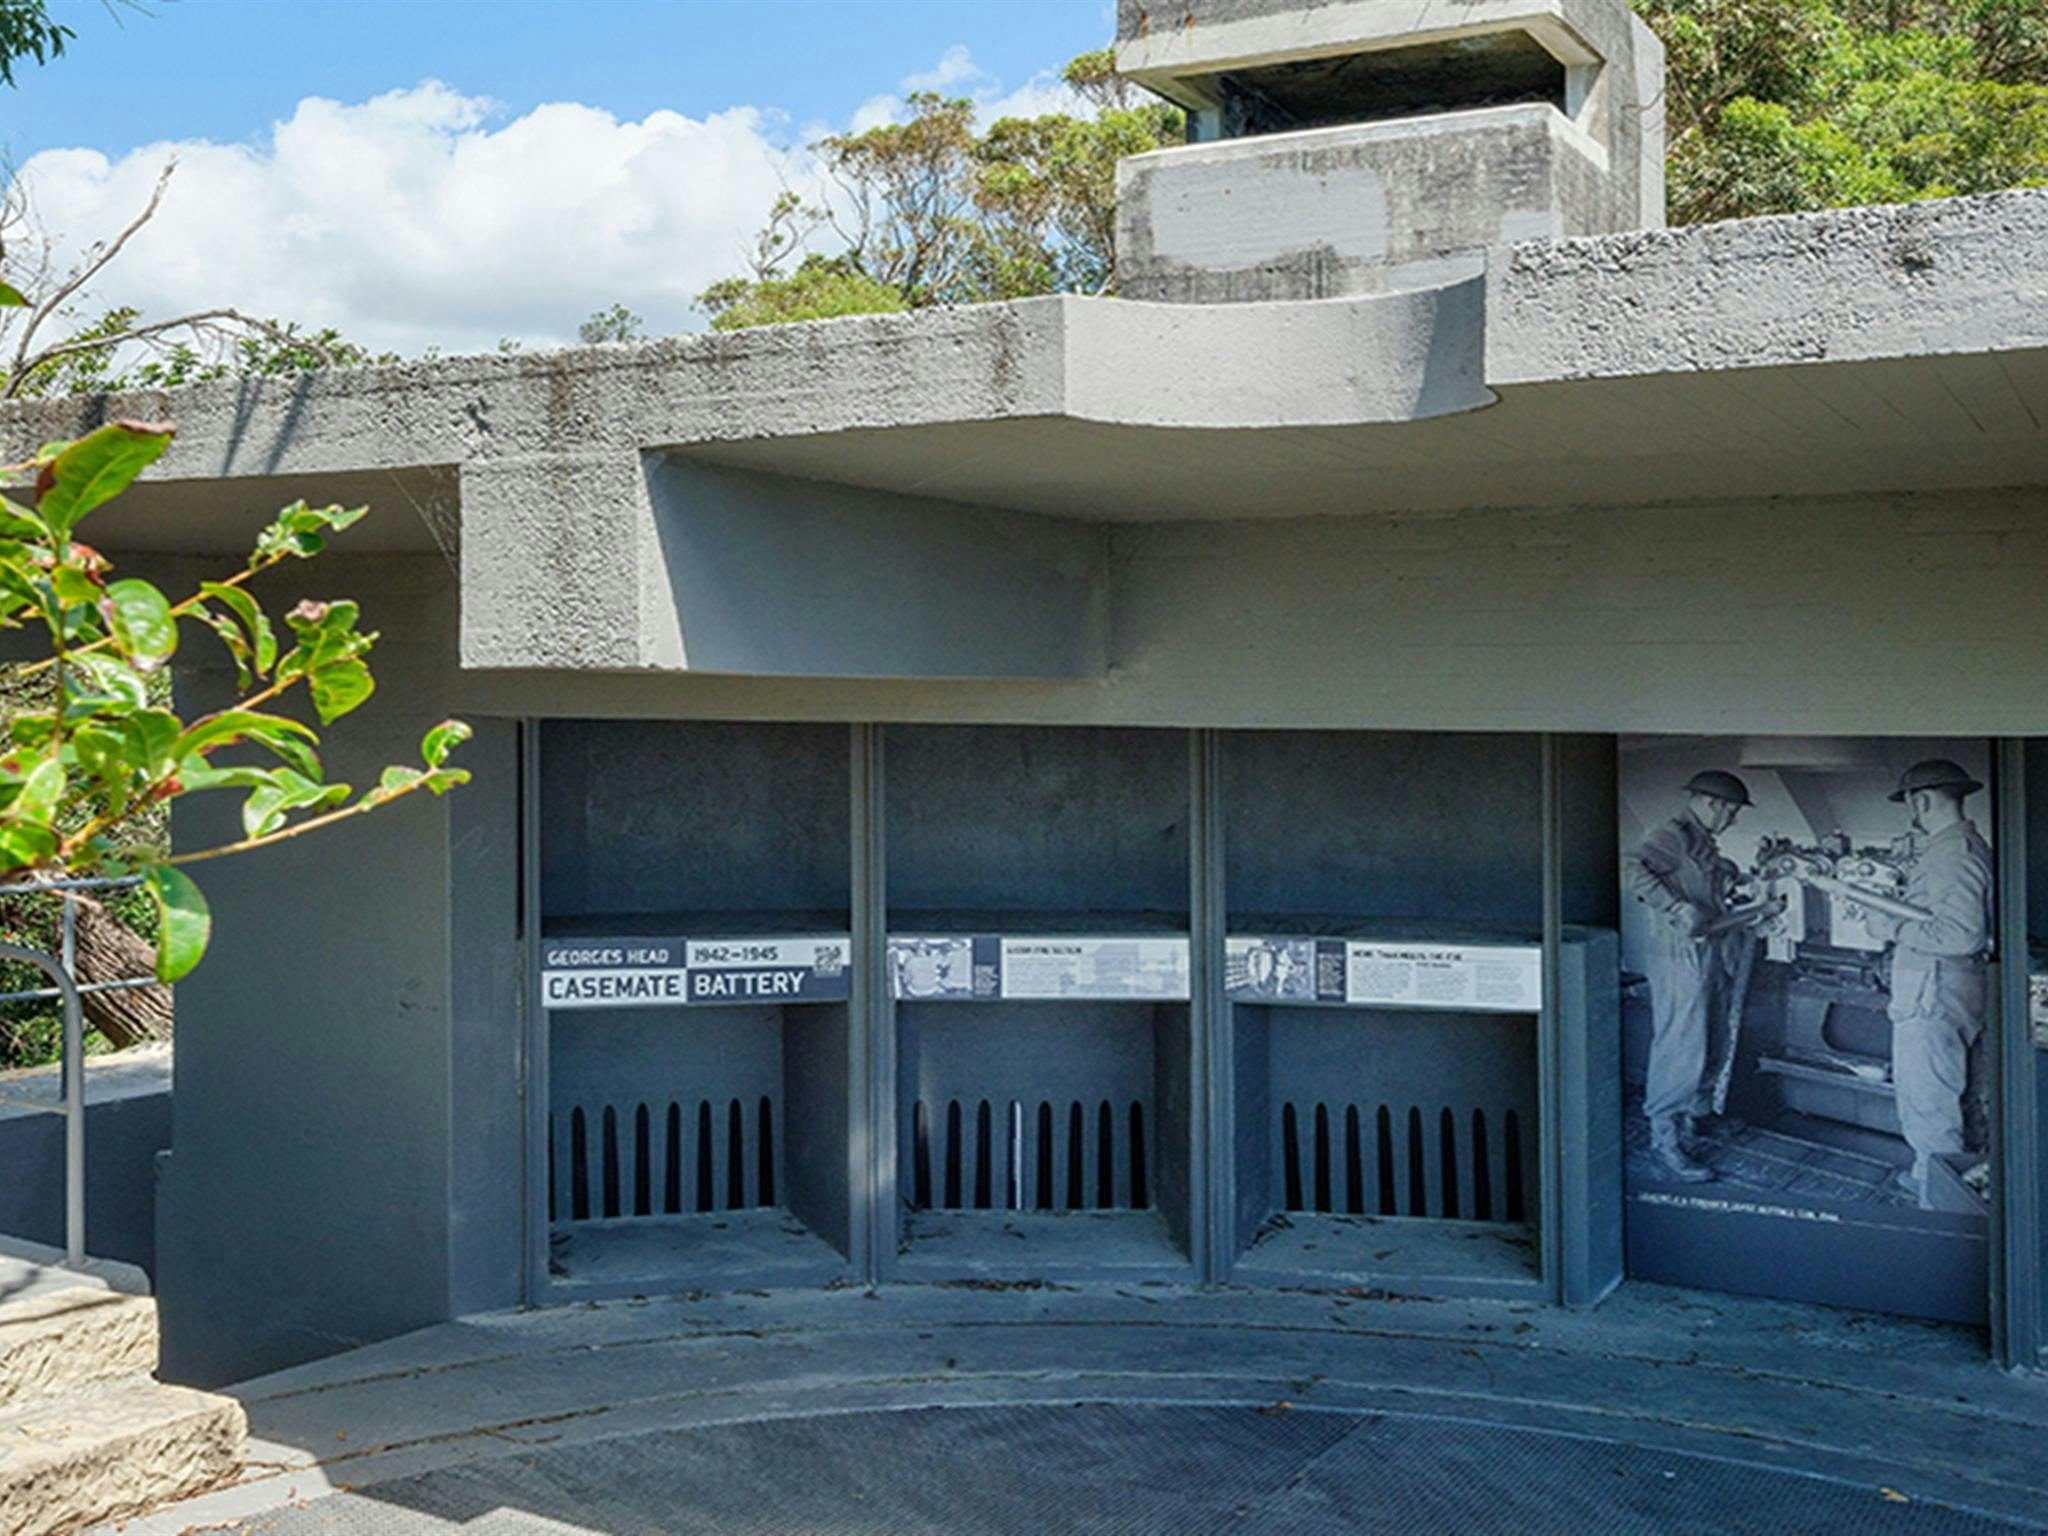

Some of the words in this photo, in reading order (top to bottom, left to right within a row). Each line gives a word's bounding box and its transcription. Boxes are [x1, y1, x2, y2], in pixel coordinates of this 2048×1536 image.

[548, 949, 622, 965] GEORGES
[627, 948, 669, 964] HEAD
[549, 975, 680, 999] CASEMATE
[694, 972, 805, 996] BATTERY
